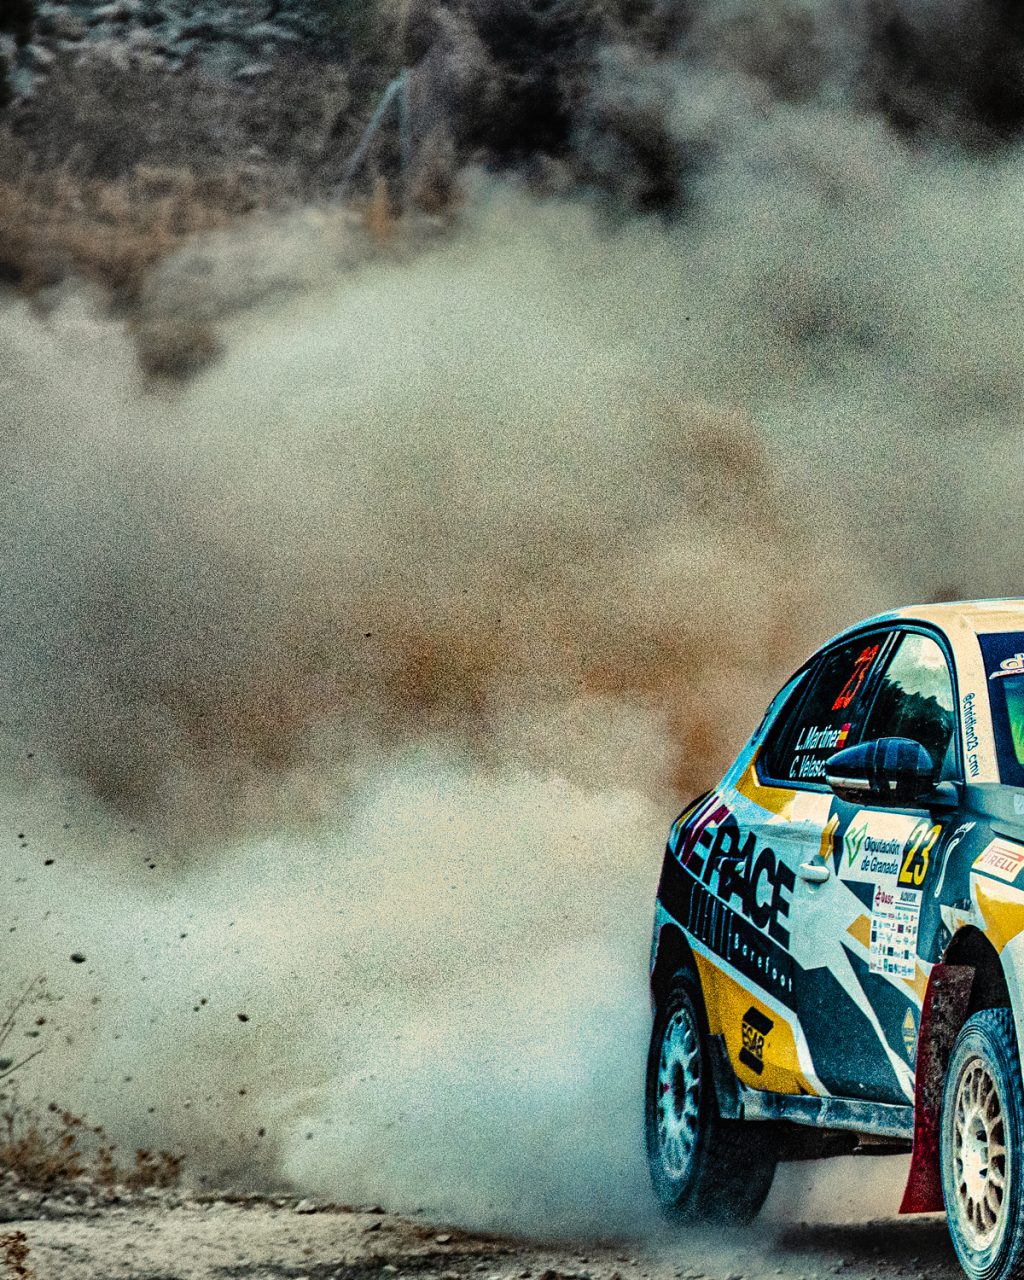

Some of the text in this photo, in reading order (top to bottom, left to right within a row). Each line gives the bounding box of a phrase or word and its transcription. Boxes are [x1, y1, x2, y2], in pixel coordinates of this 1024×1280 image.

[799, 754, 828, 777] Velasc
[864, 836, 900, 855] Diputación
[898, 823, 942, 885] 23
[860, 856, 899, 875] de Granada
